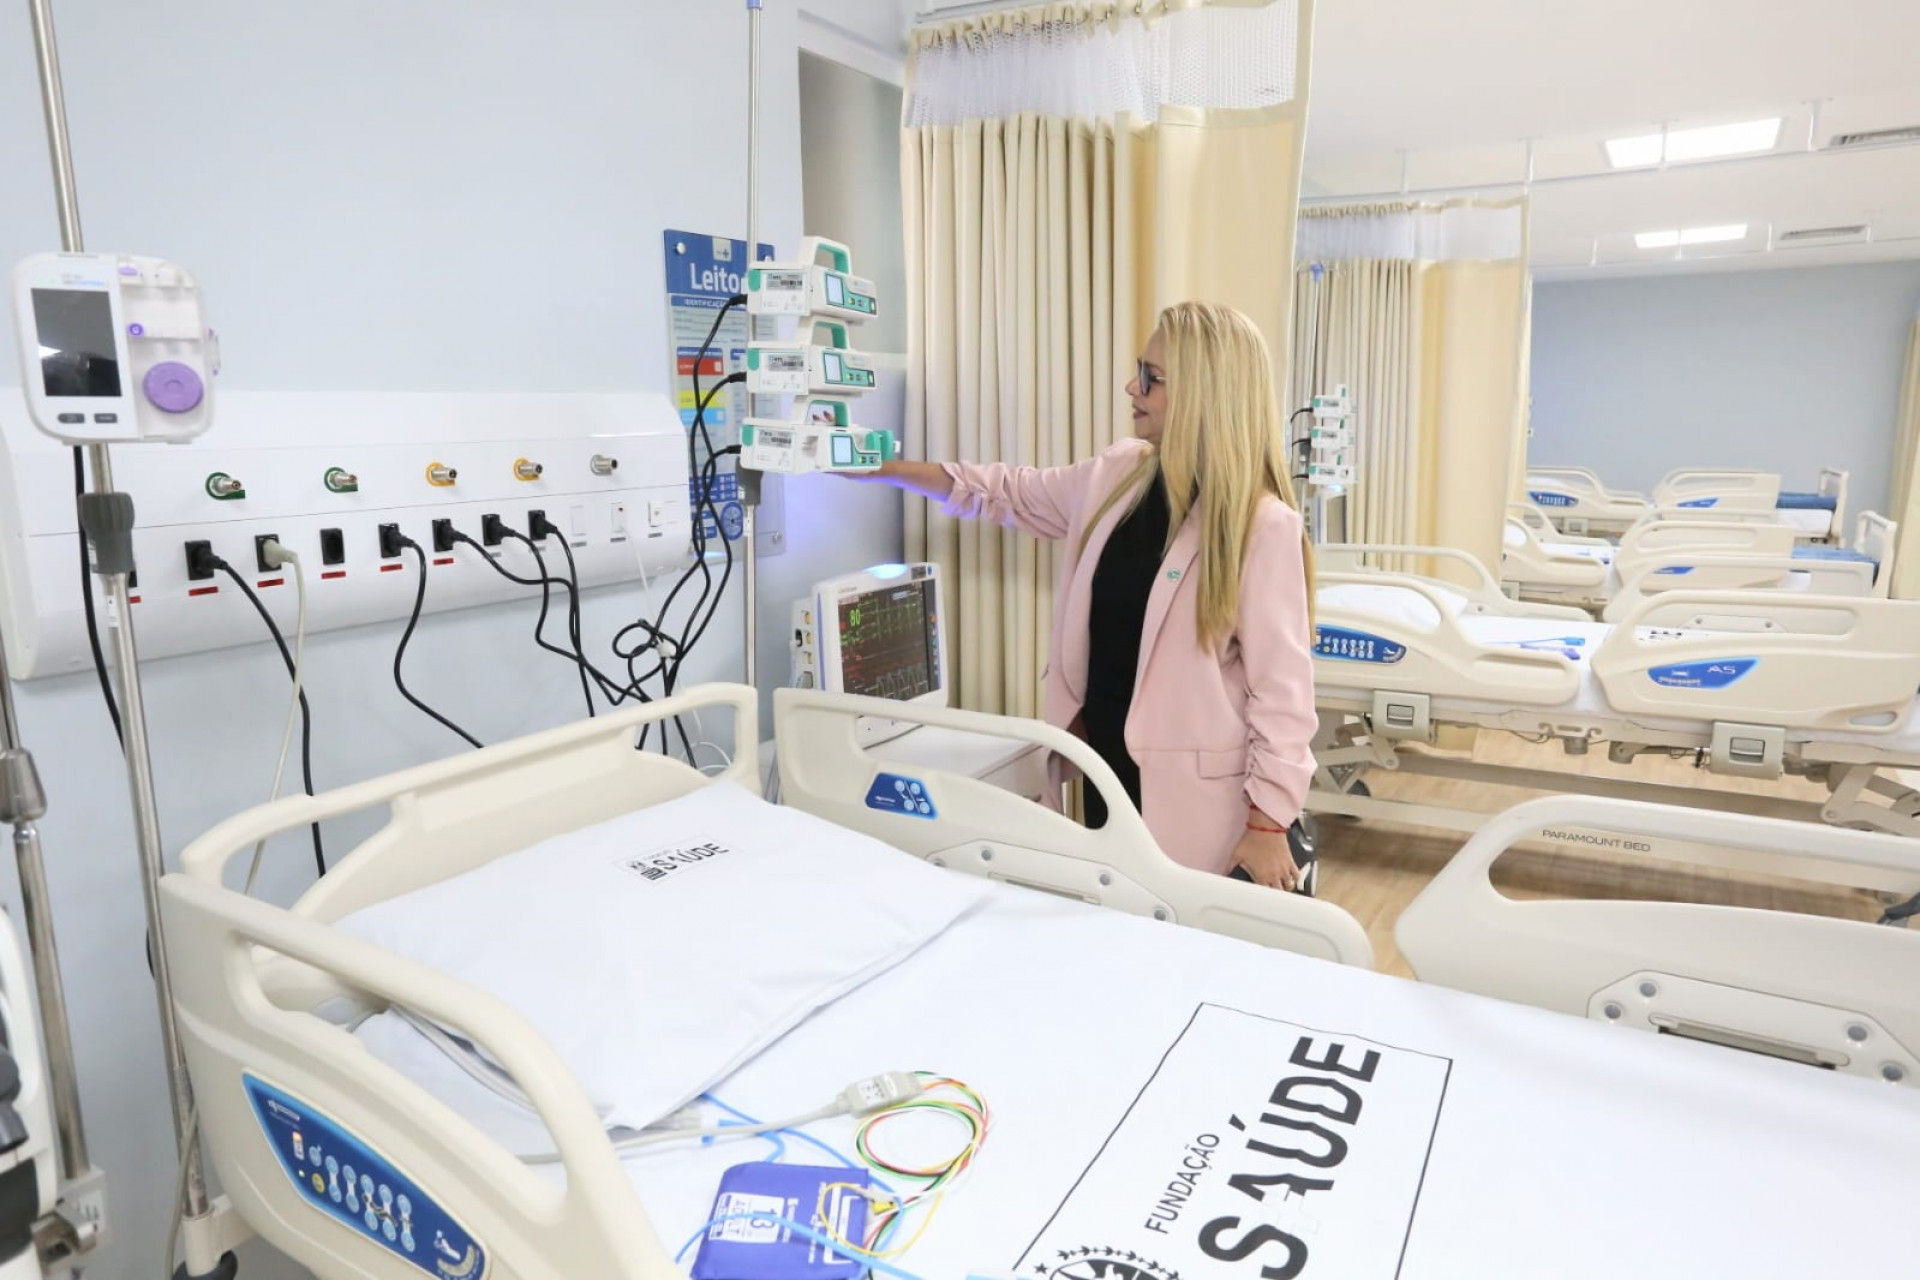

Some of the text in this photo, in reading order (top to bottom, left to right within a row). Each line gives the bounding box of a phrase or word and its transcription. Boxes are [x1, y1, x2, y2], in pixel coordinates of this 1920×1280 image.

[690, 262, 740, 294] Leito
[1542, 829, 1651, 852] PARAMOUNT BED
[1144, 1132, 1221, 1234] FUNDAÇÃO
[1197, 1035, 1381, 1280] SAÚDE
